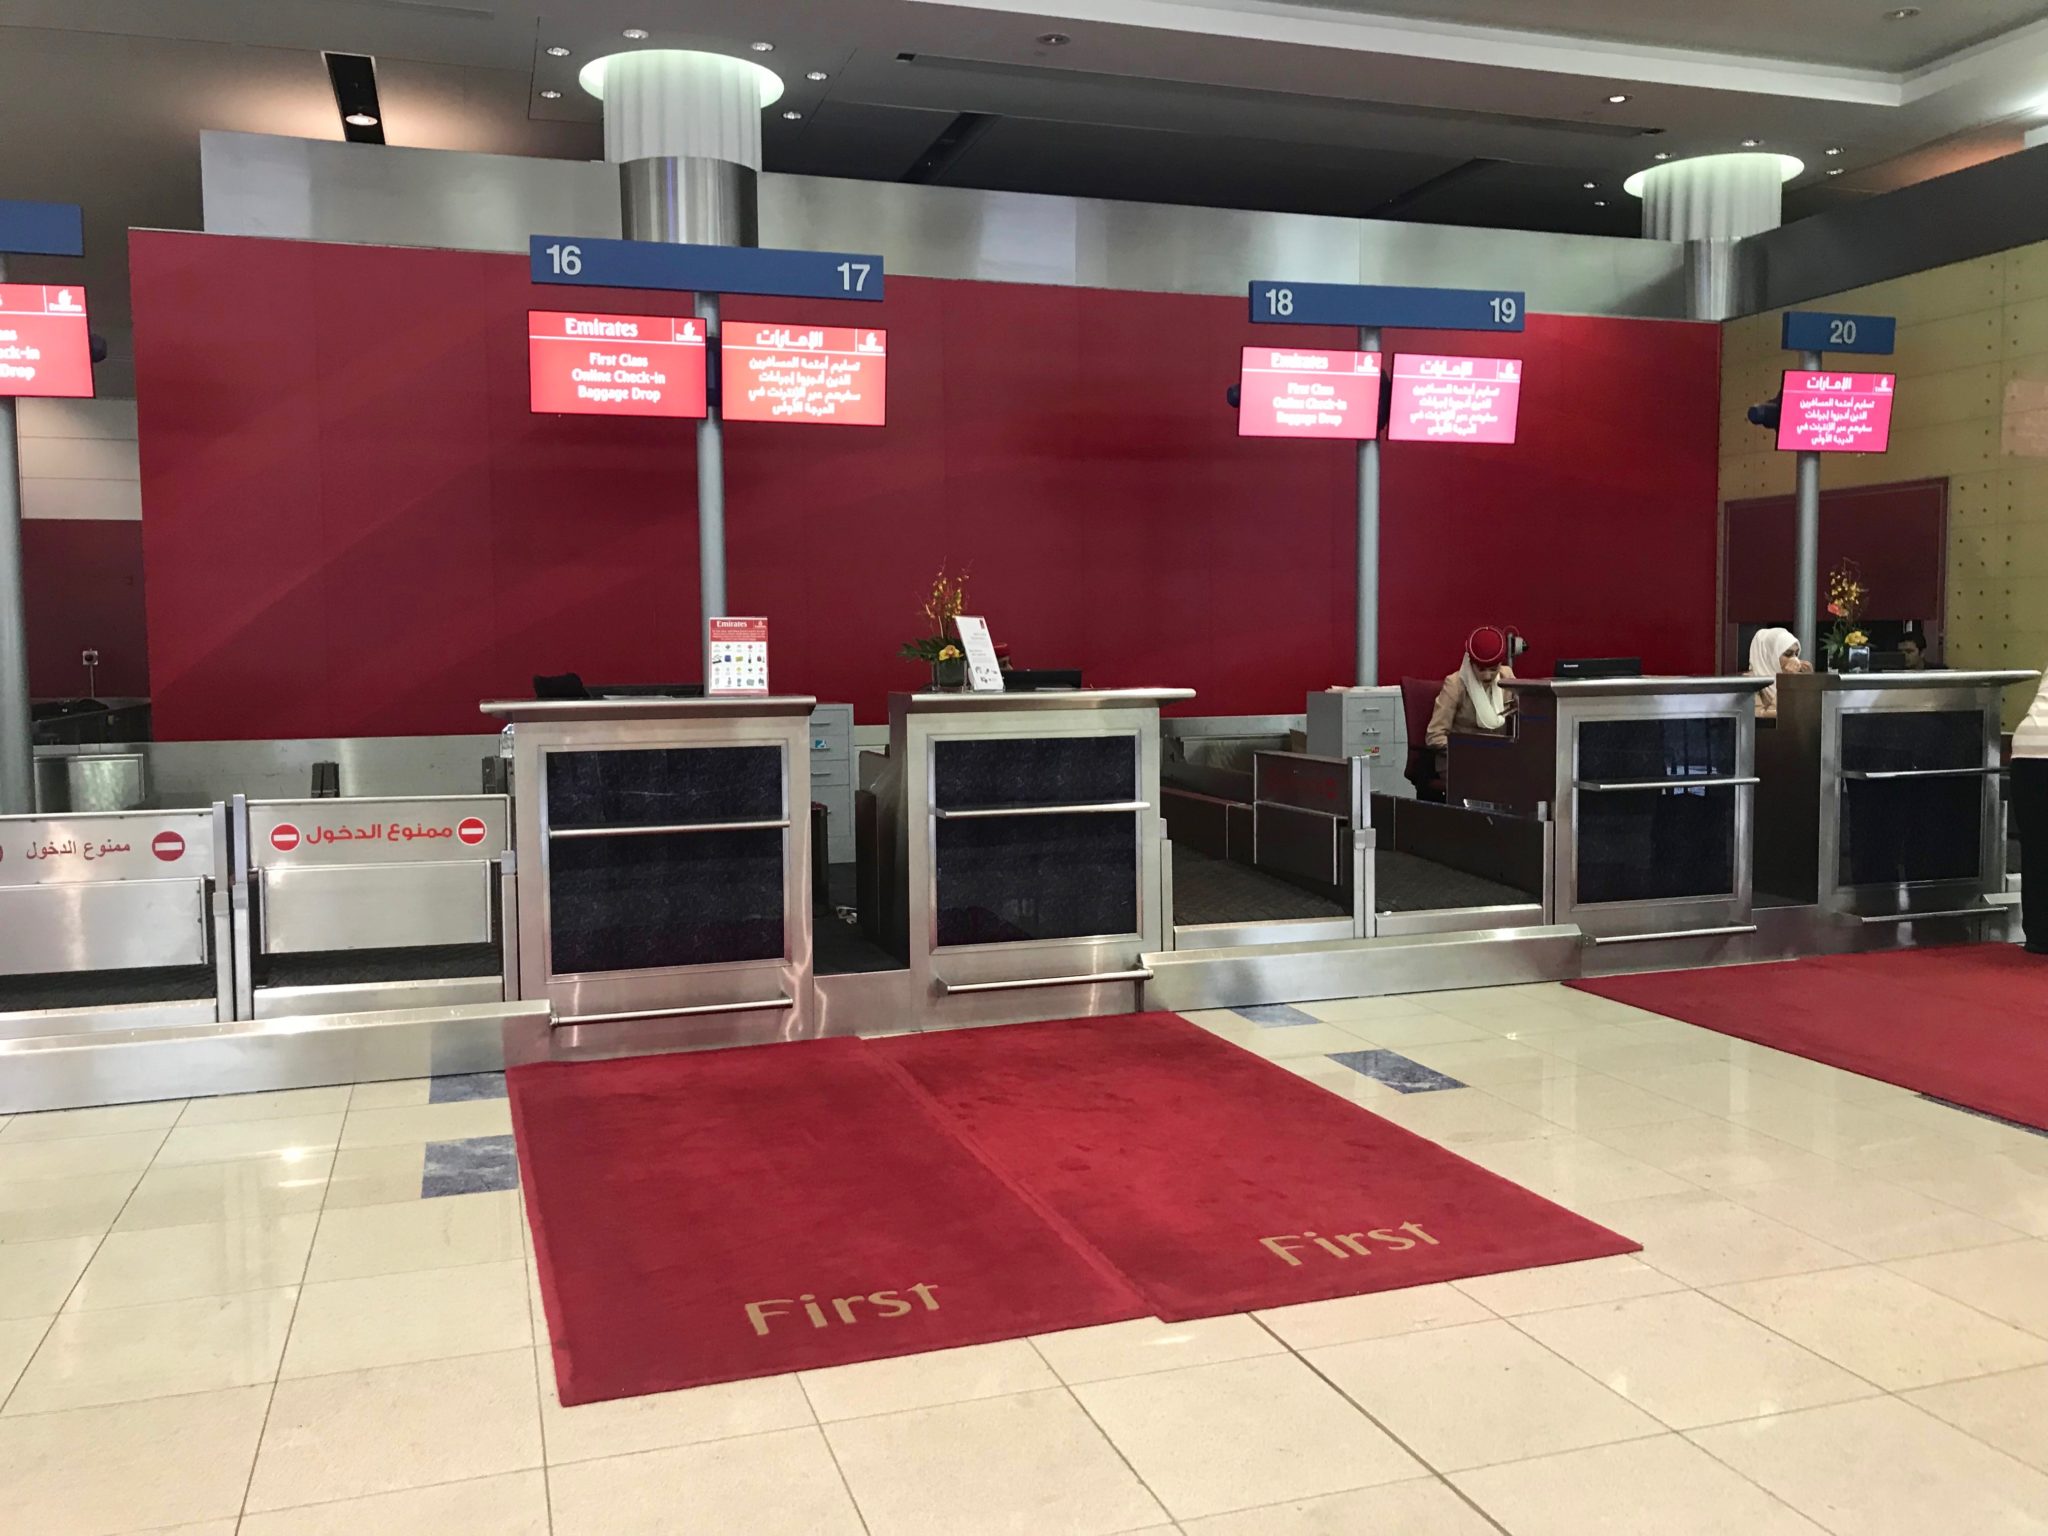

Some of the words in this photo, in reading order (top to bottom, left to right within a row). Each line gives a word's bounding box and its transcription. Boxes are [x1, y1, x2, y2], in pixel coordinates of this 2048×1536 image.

[546, 244, 582, 276] 16
[837, 262, 871, 292] 17
[1265, 288, 1293, 316] 18
[1489, 297, 1517, 324] 19
[564, 317, 638, 337] Emirates
[1829, 319, 1857, 344] 20
[589, 352, 616, 366] First
[618, 353, 648, 367] Class
[572, 368, 612, 382] Online
[613, 370, 666, 384] Check-in
[577, 385, 629, 402] Baggage
[631, 387, 661, 403] Drop
[717, 620, 748, 629] Emirates
[306, 823, 382, 844] الدخول
[387, 822, 454, 842] ممنوع
[26, 839, 77, 860] الدخول
[82, 838, 131, 861] ممنوع
[1259, 1220, 1440, 1267] First
[745, 1282, 940, 1336] First
